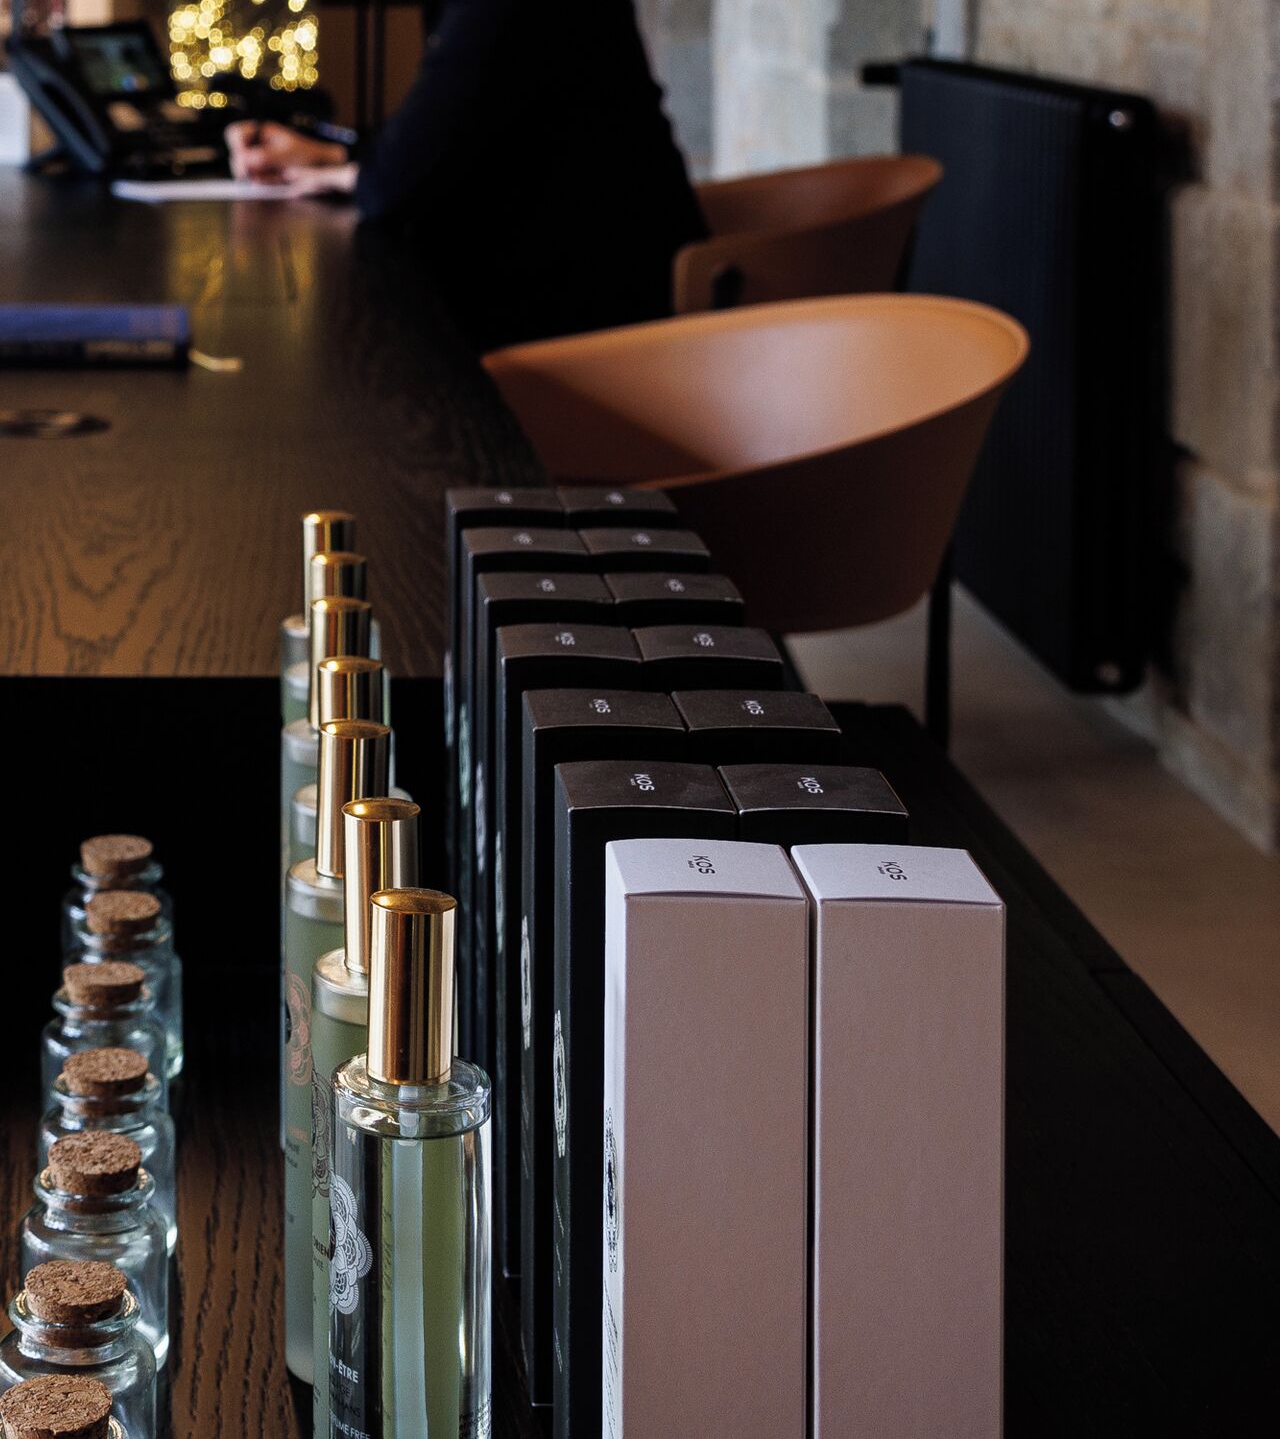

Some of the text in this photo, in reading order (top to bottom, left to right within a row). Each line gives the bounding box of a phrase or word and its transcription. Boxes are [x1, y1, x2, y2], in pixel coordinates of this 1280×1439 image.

[634, 773, 655, 791] KOS
[800, 776, 824, 794] KOS
[692, 855, 716, 874] KOS
[880, 861, 908, 880] KOS
